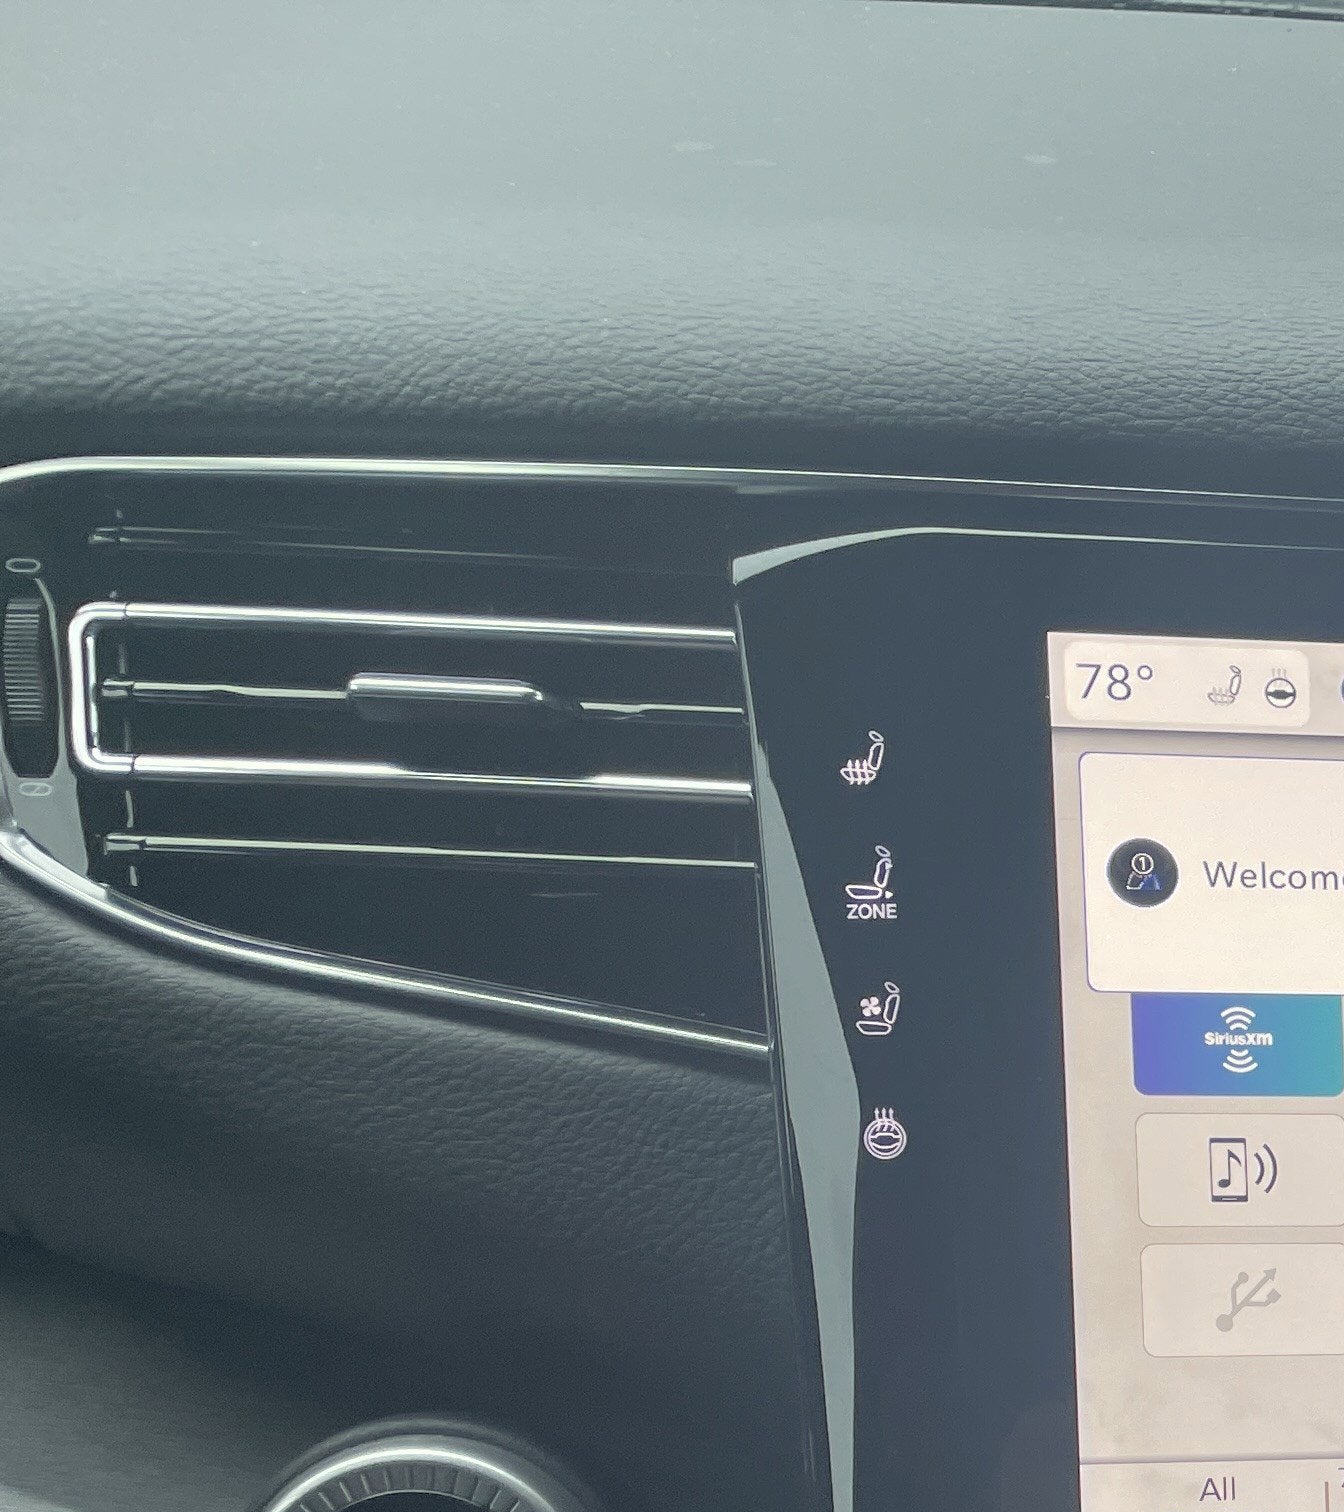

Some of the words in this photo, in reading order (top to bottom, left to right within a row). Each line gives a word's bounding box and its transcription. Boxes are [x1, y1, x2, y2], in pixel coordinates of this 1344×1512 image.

[1075, 663, 1154, 701] 78°
[846, 902, 898, 920] ZONE
[1199, 1476, 1236, 1502] All
